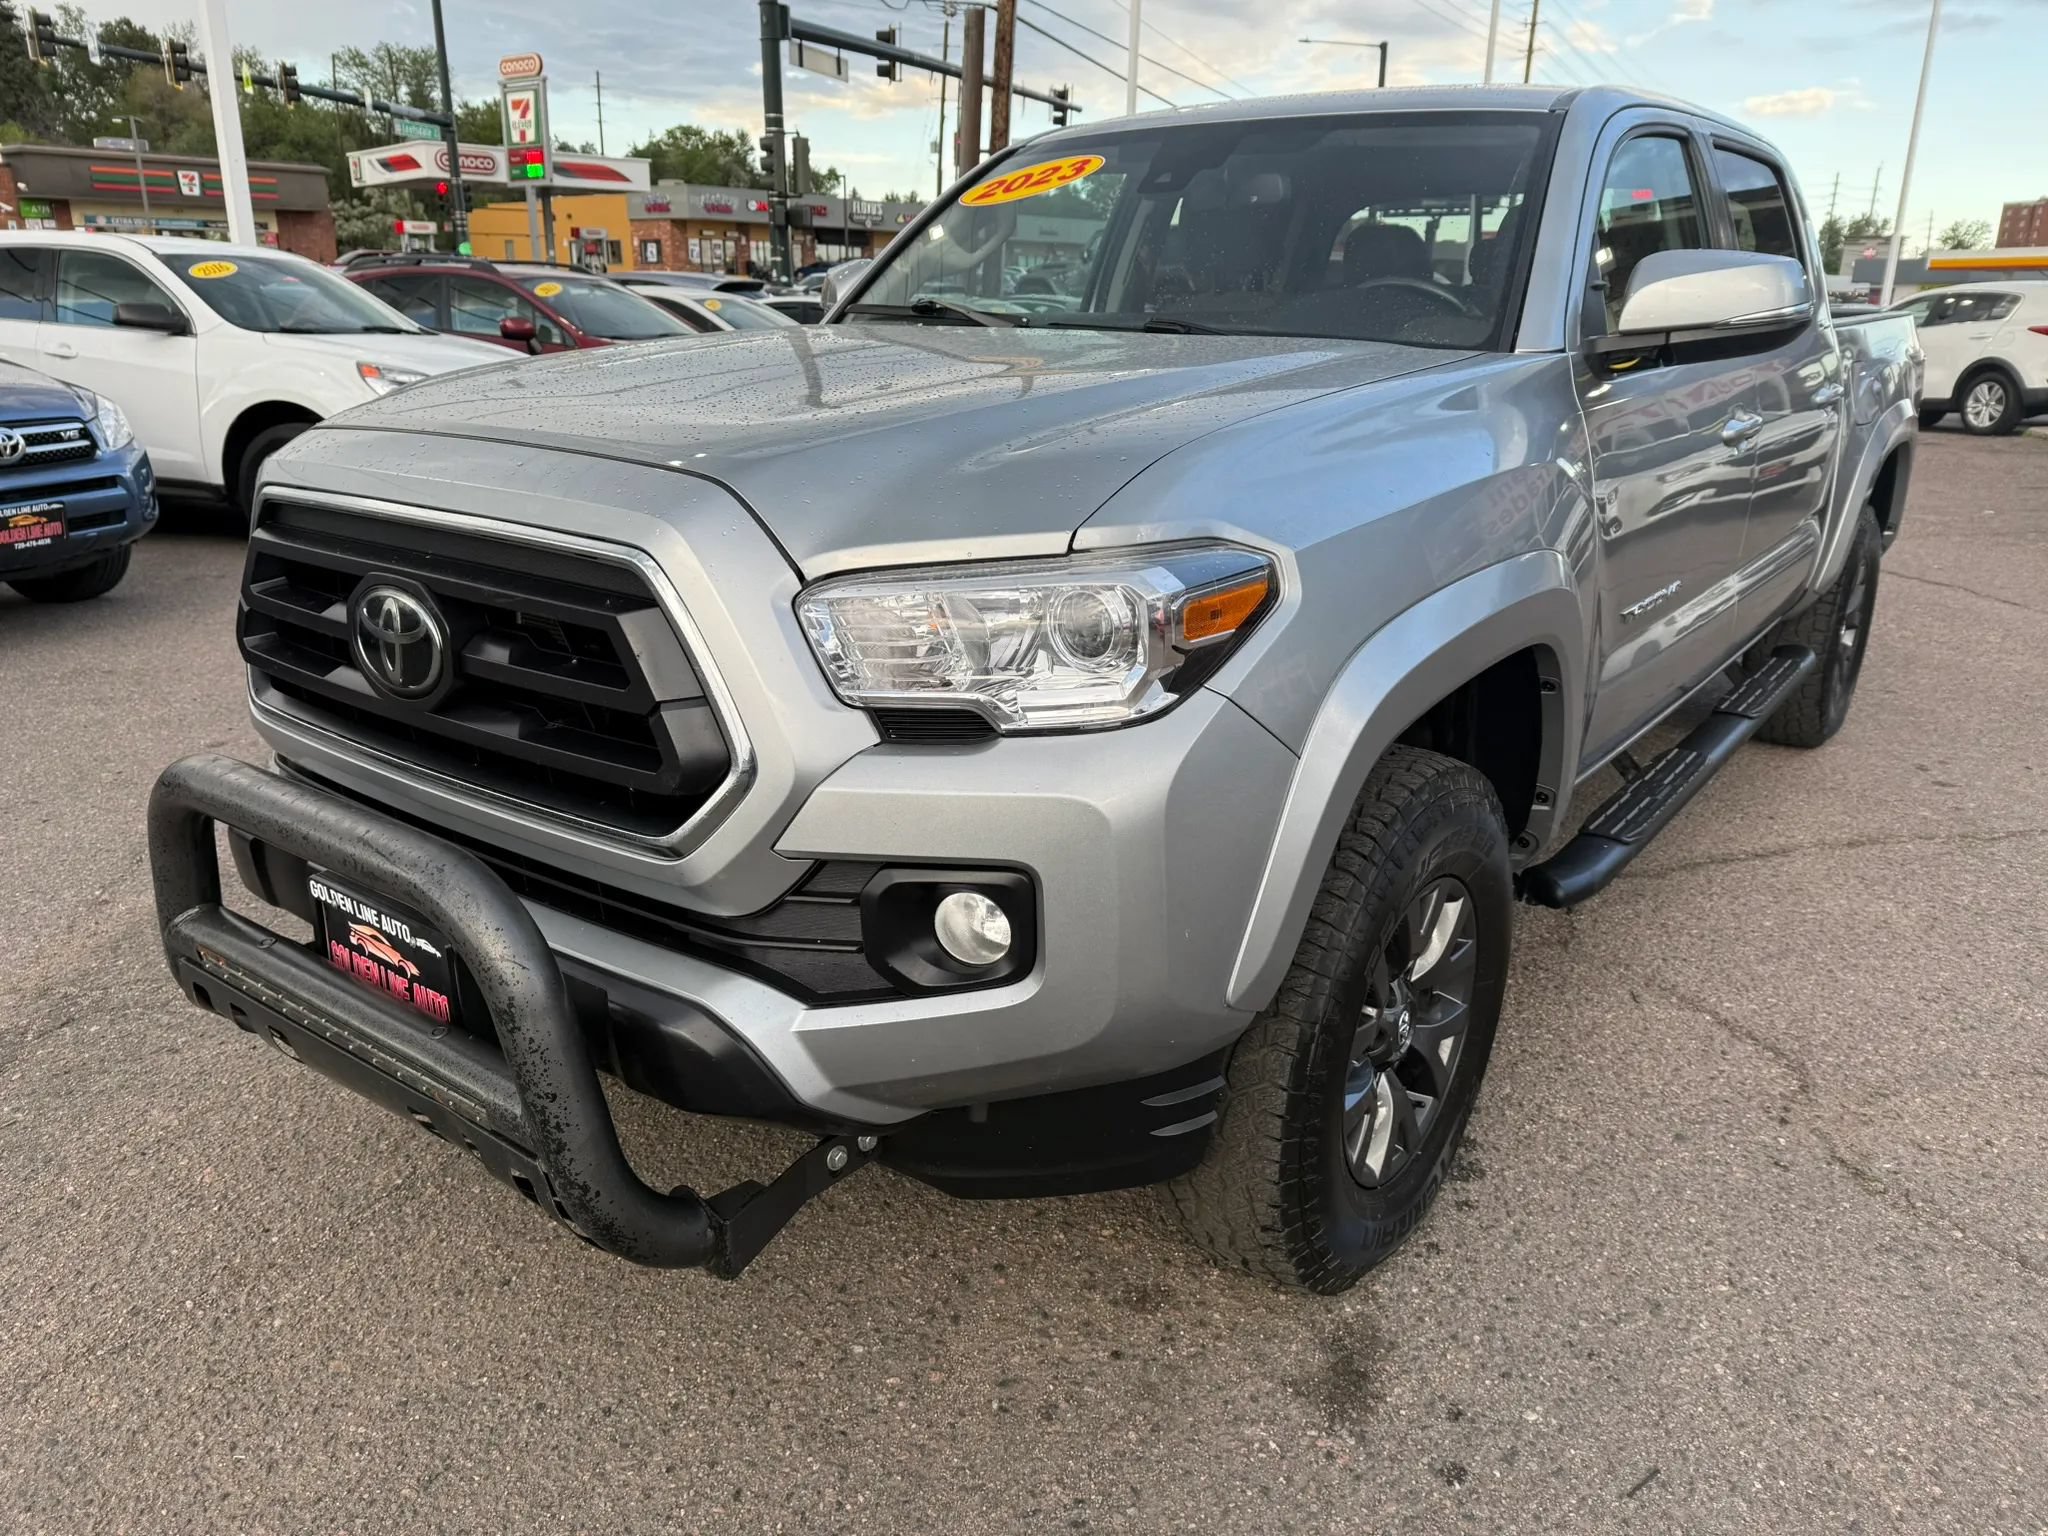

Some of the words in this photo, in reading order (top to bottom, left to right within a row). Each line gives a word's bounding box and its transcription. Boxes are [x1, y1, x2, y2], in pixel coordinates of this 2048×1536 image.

[441, 155, 494, 169] cnoco
[972, 159, 1092, 202] 2023
[60, 430, 80, 441] V6
[32, 503, 48, 512] AUTO
[309, 879, 354, 915] GOLDEN
[353, 900, 381, 928] LINE
[381, 914, 411, 944] AUTO
